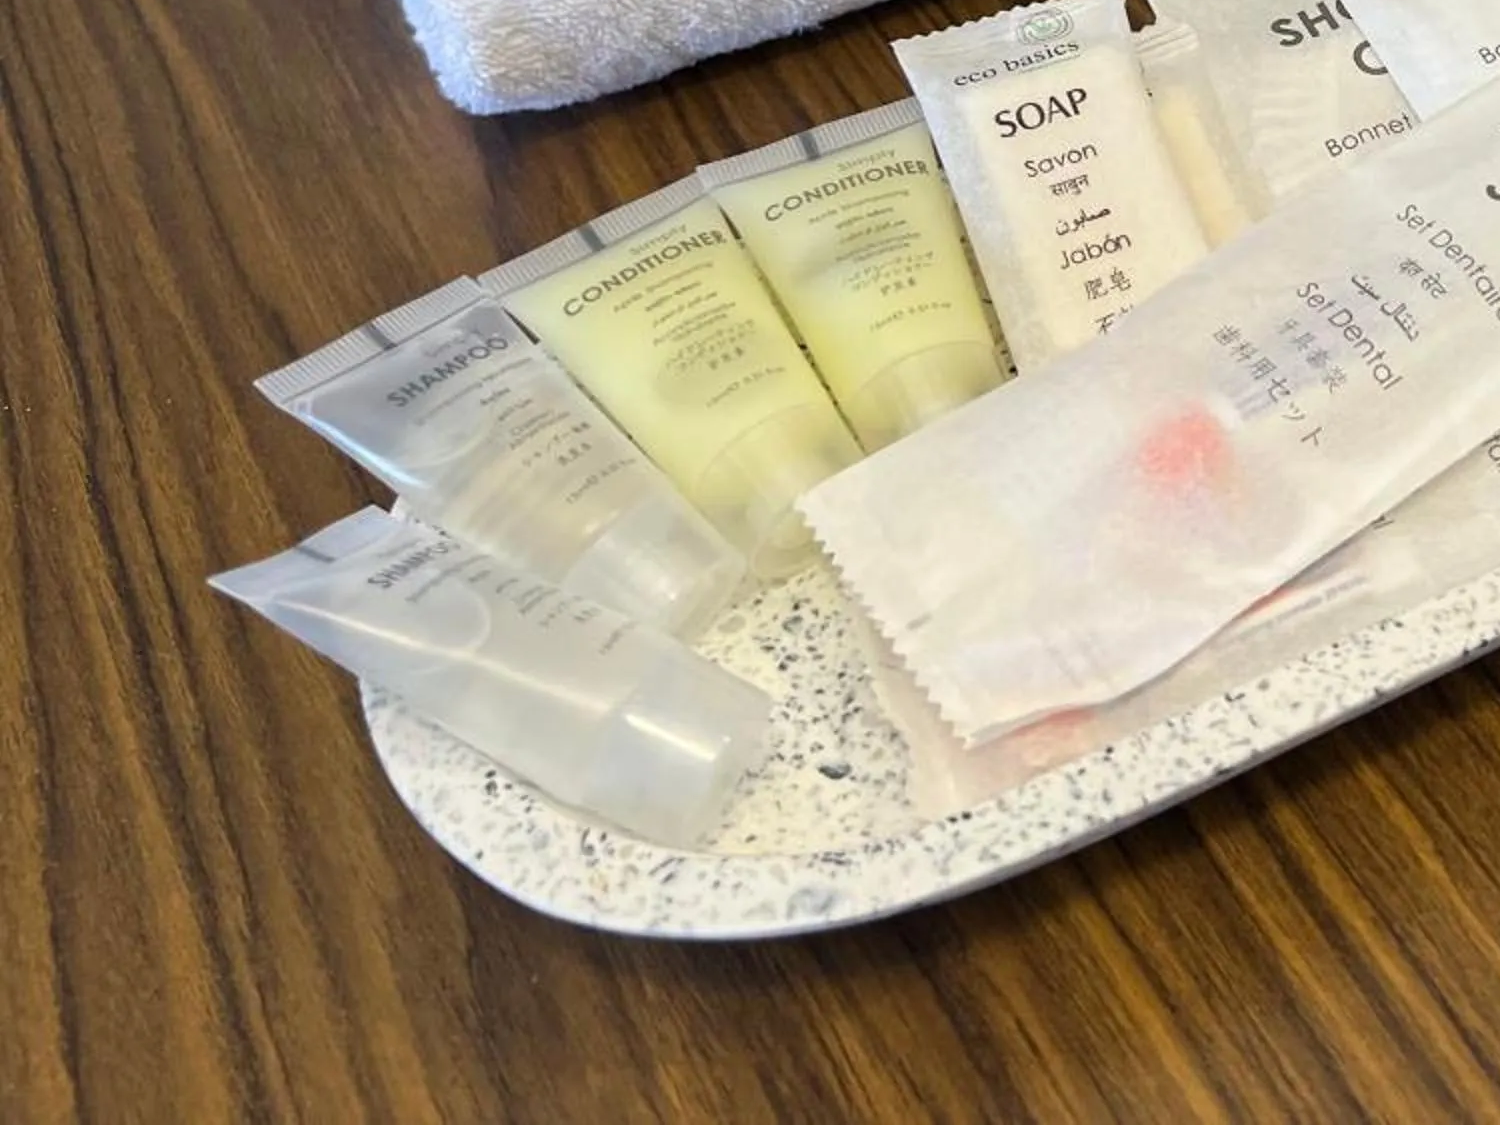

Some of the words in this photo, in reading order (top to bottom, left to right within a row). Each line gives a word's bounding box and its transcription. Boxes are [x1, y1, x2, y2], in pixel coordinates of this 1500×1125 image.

[953, 68, 997, 87] eco
[1003, 42, 1079, 72] basics
[994, 87, 1087, 138] SOAP
[1325, 112, 1413, 157] Bonnet
[1023, 143, 1098, 178] Savon
[764, 160, 930, 222] CONDITIONER
[1396, 203, 1436, 234] Set
[562, 230, 727, 317] CONDITIONER
[1060, 233, 1132, 270] Jabón
[1084, 267, 1132, 300] 肥皂
[1296, 282, 1336, 313] Set
[1328, 308, 1403, 391] Dental
[386, 337, 508, 408] SHAMPOO
